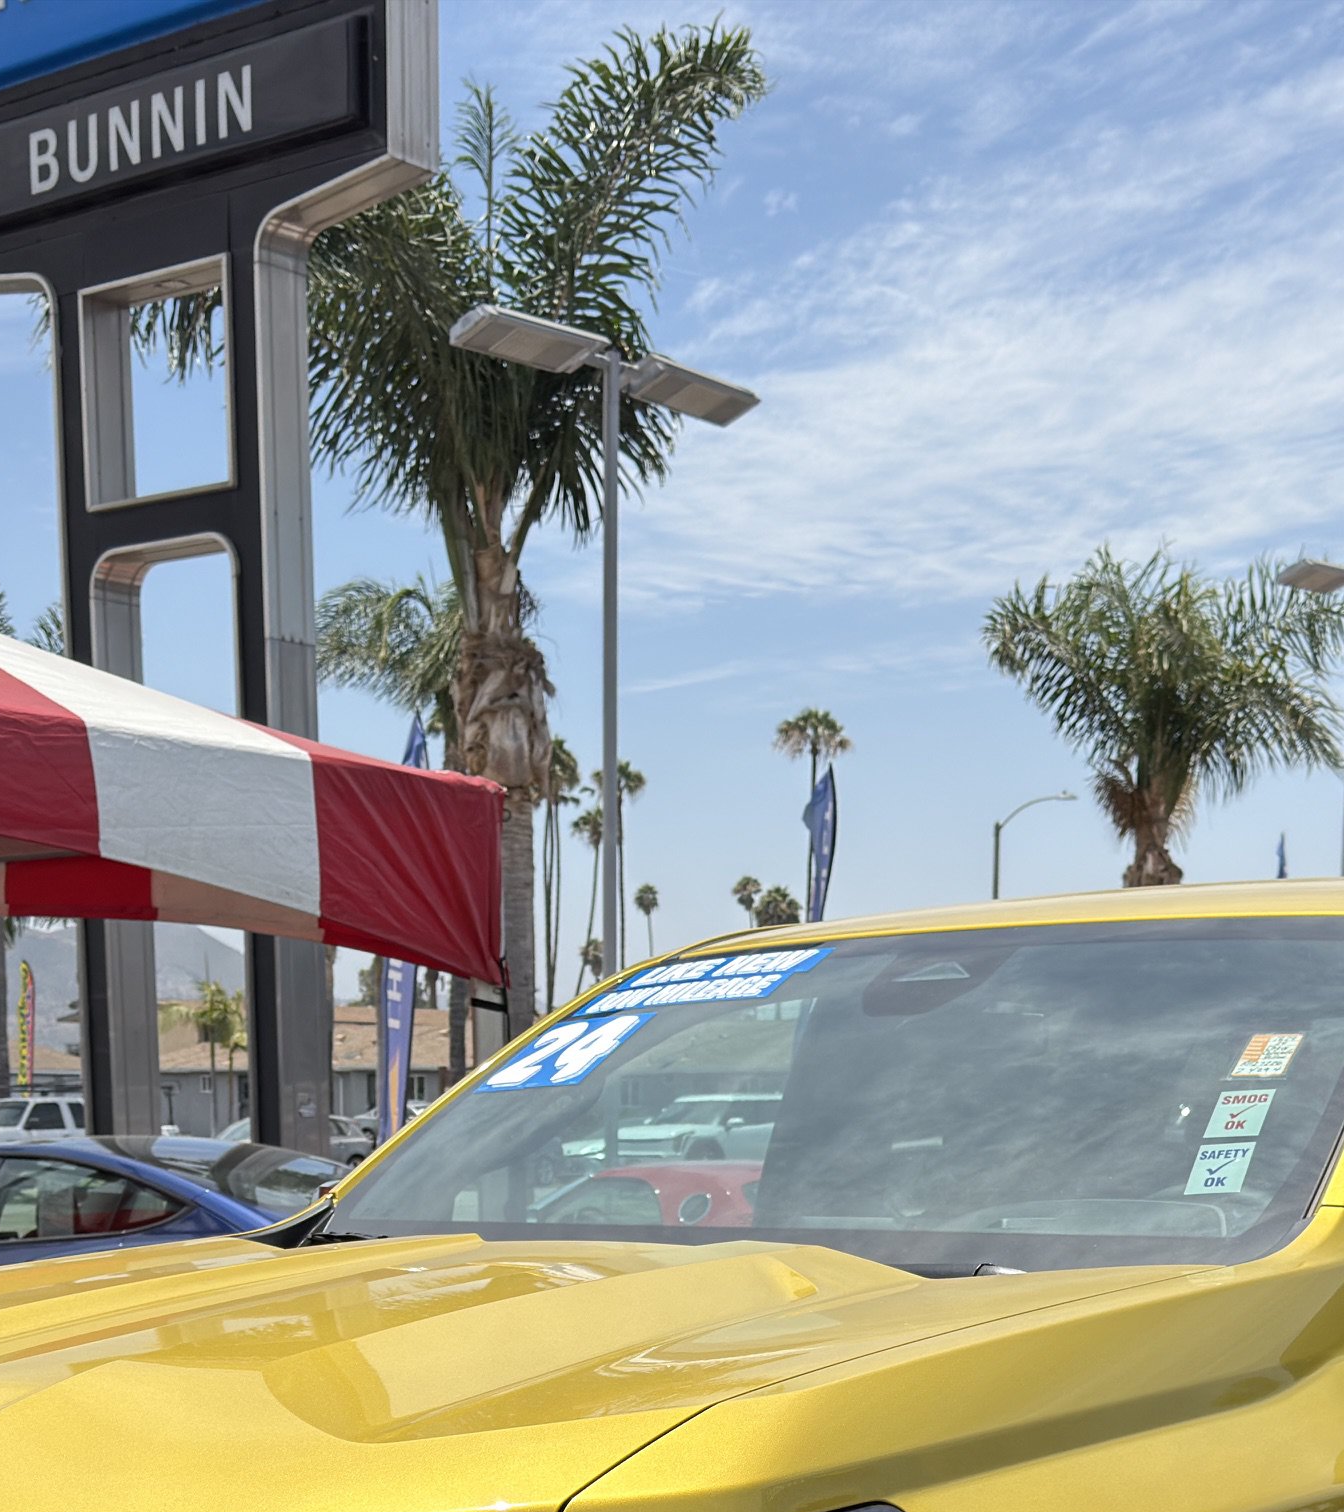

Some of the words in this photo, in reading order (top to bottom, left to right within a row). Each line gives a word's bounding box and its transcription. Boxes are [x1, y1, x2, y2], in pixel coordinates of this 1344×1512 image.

[28, 64, 253, 195] BUNNIN
[630, 958, 727, 988] LIKE
[711, 949, 820, 977] NEW
[586, 986, 664, 1014] LOW
[643, 974, 782, 1006] MILEAGE
[487, 1015, 640, 1088] 24
[1221, 1093, 1269, 1105] SMOG
[1224, 1120, 1246, 1130] OK
[1199, 1148, 1249, 1160] SAFETY
[1203, 1176, 1227, 1187] OK
